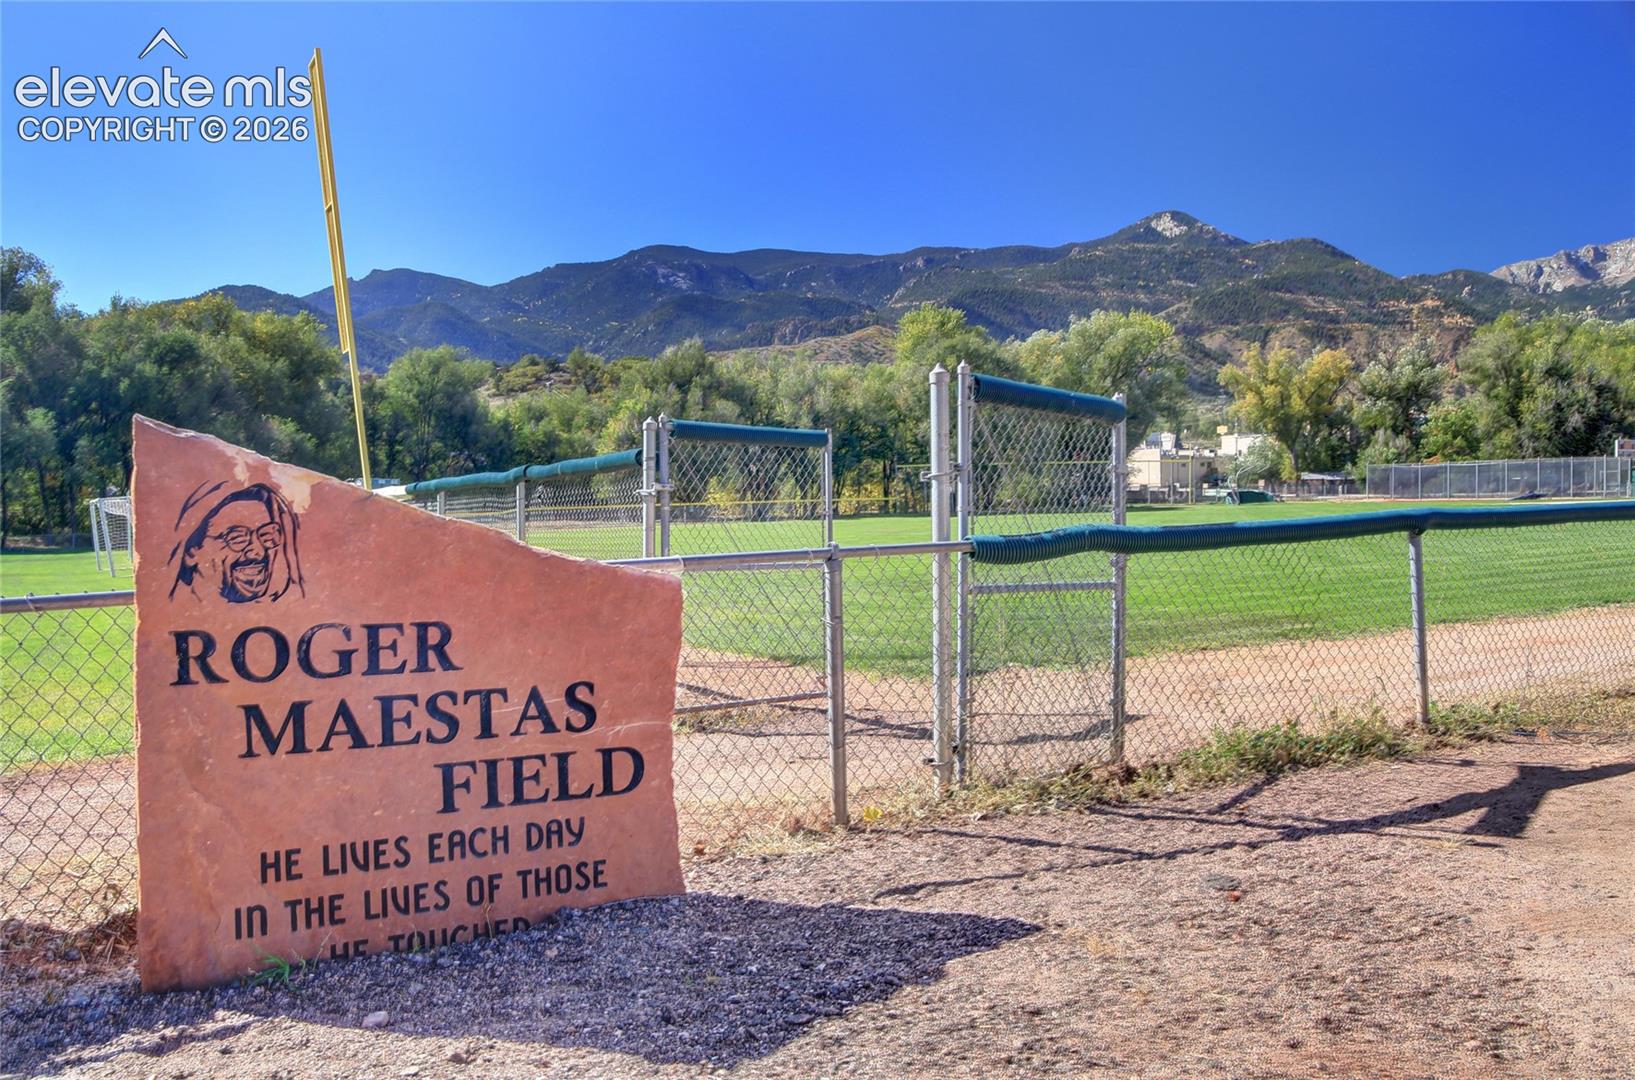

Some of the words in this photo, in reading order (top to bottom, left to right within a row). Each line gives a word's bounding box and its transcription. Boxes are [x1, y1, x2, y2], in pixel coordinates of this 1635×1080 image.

[169, 621, 463, 686] ROGER
[238, 681, 598, 758] MAESTAS
[434, 746, 645, 813] FIELD
[260, 848, 304, 884] HE
[322, 835, 412, 876] LIVES
[428, 824, 510, 864] EACH
[526, 816, 586, 852] DAY
[284, 893, 346, 932] THE
[364, 879, 451, 921] LIVES
[466, 873, 503, 906] OF
[517, 859, 609, 899] THOSE
